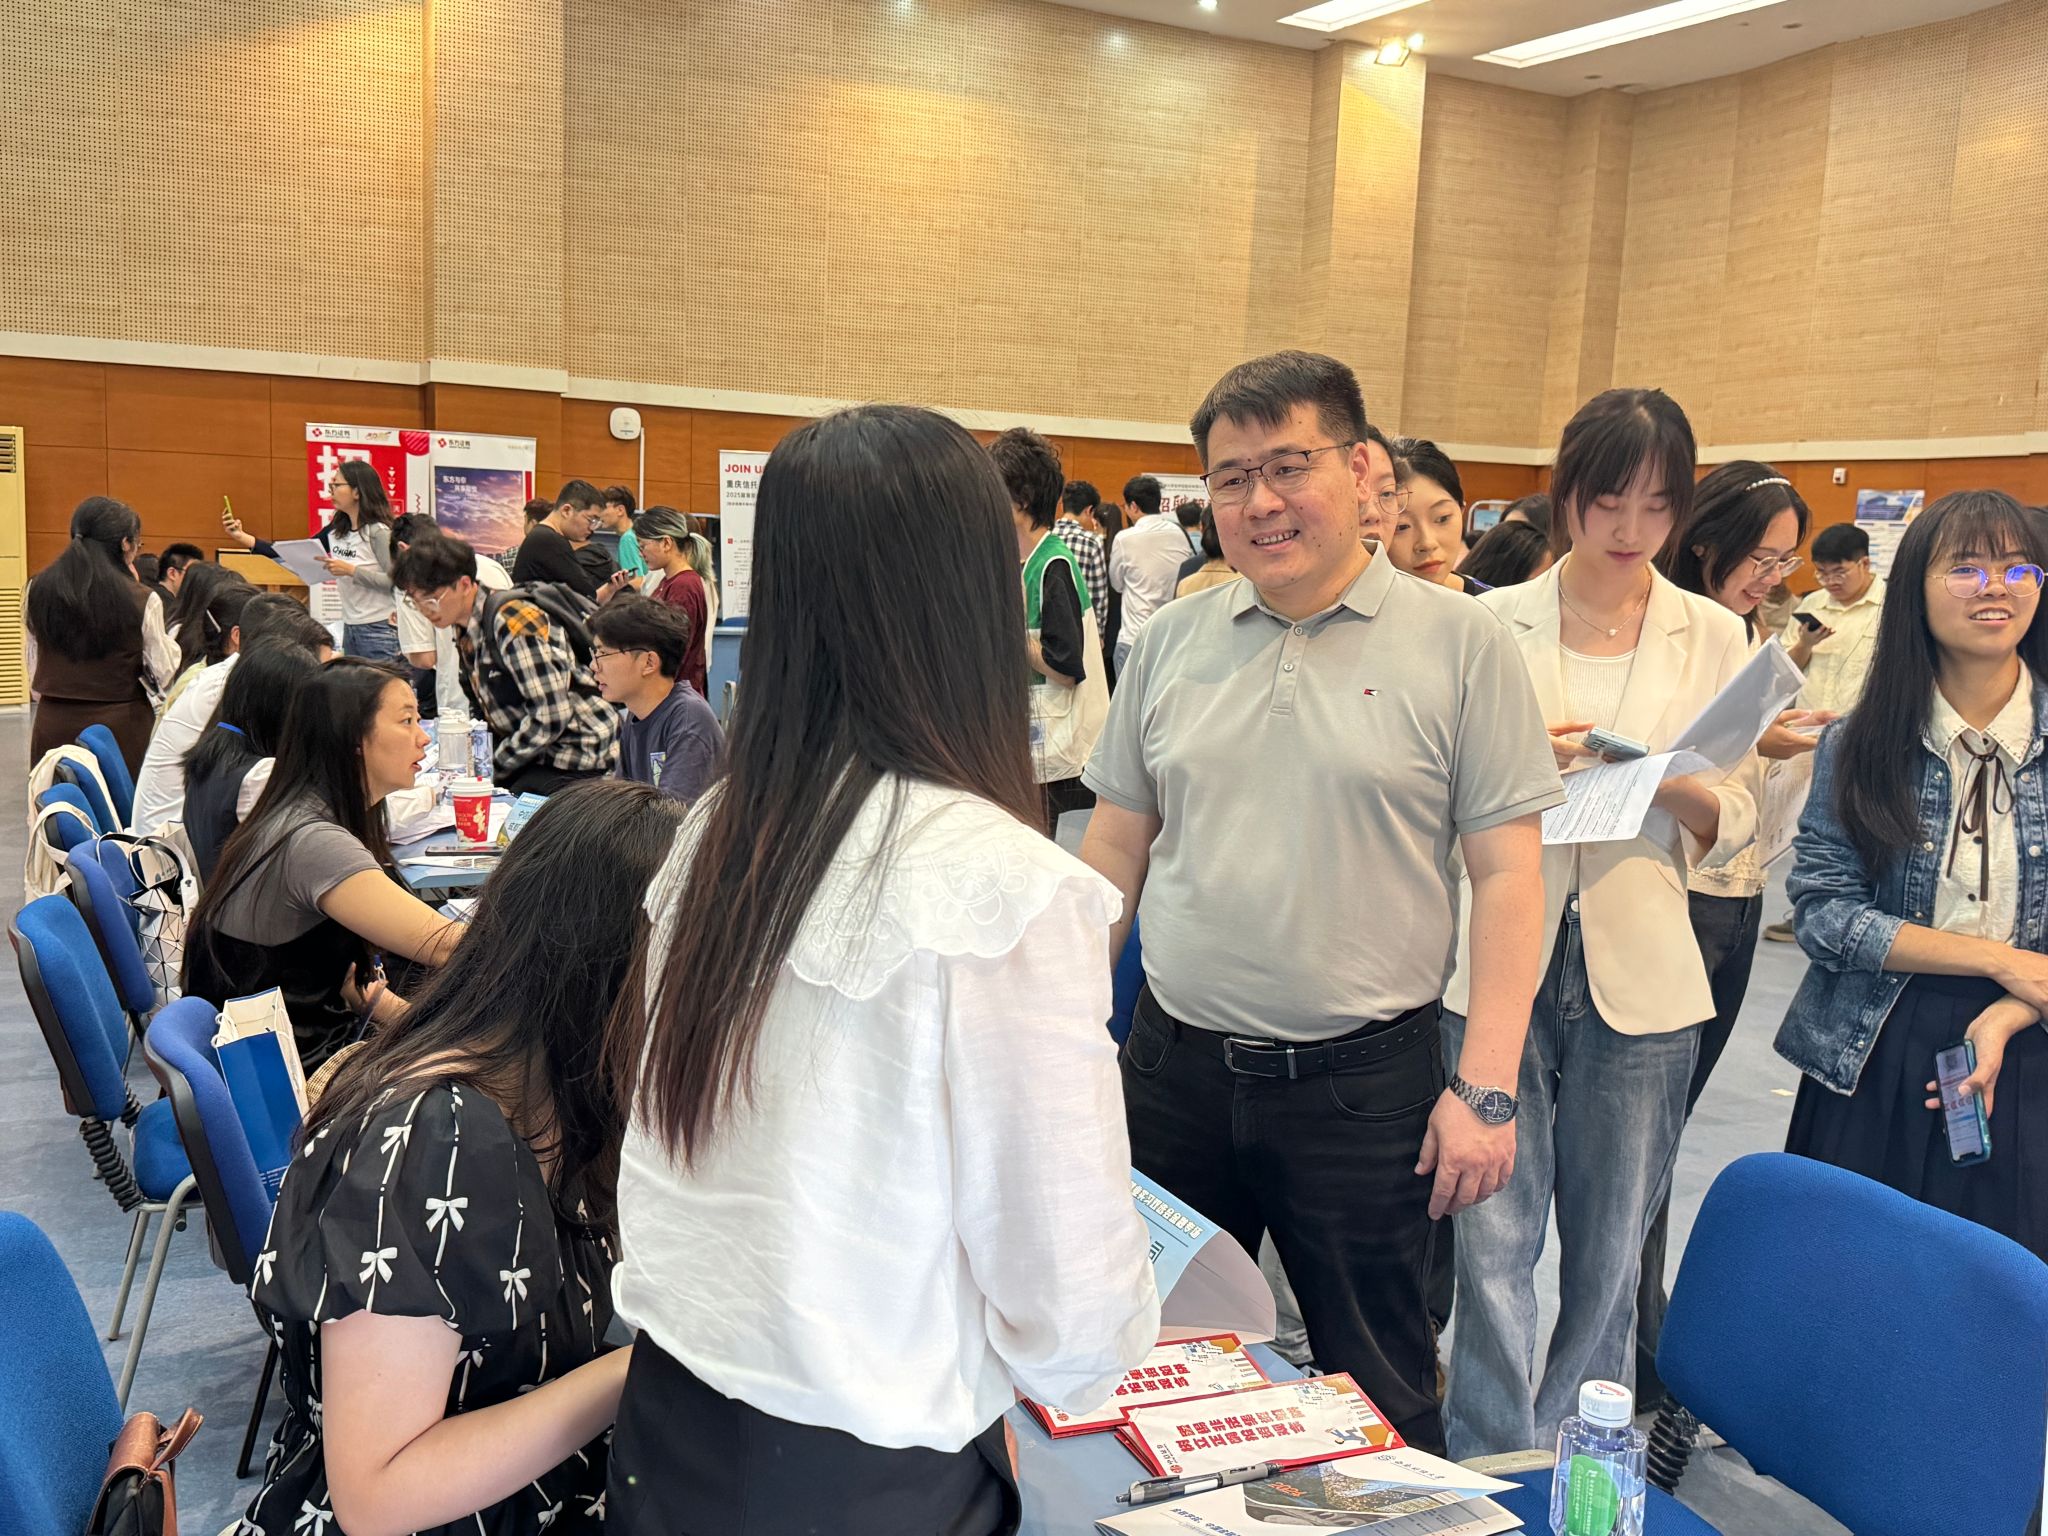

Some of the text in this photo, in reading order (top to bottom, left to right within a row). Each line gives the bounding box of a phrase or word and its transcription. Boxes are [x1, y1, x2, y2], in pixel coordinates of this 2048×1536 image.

[724, 464, 766, 475] JOIN U
[726, 480, 758, 489] 重庆信托
